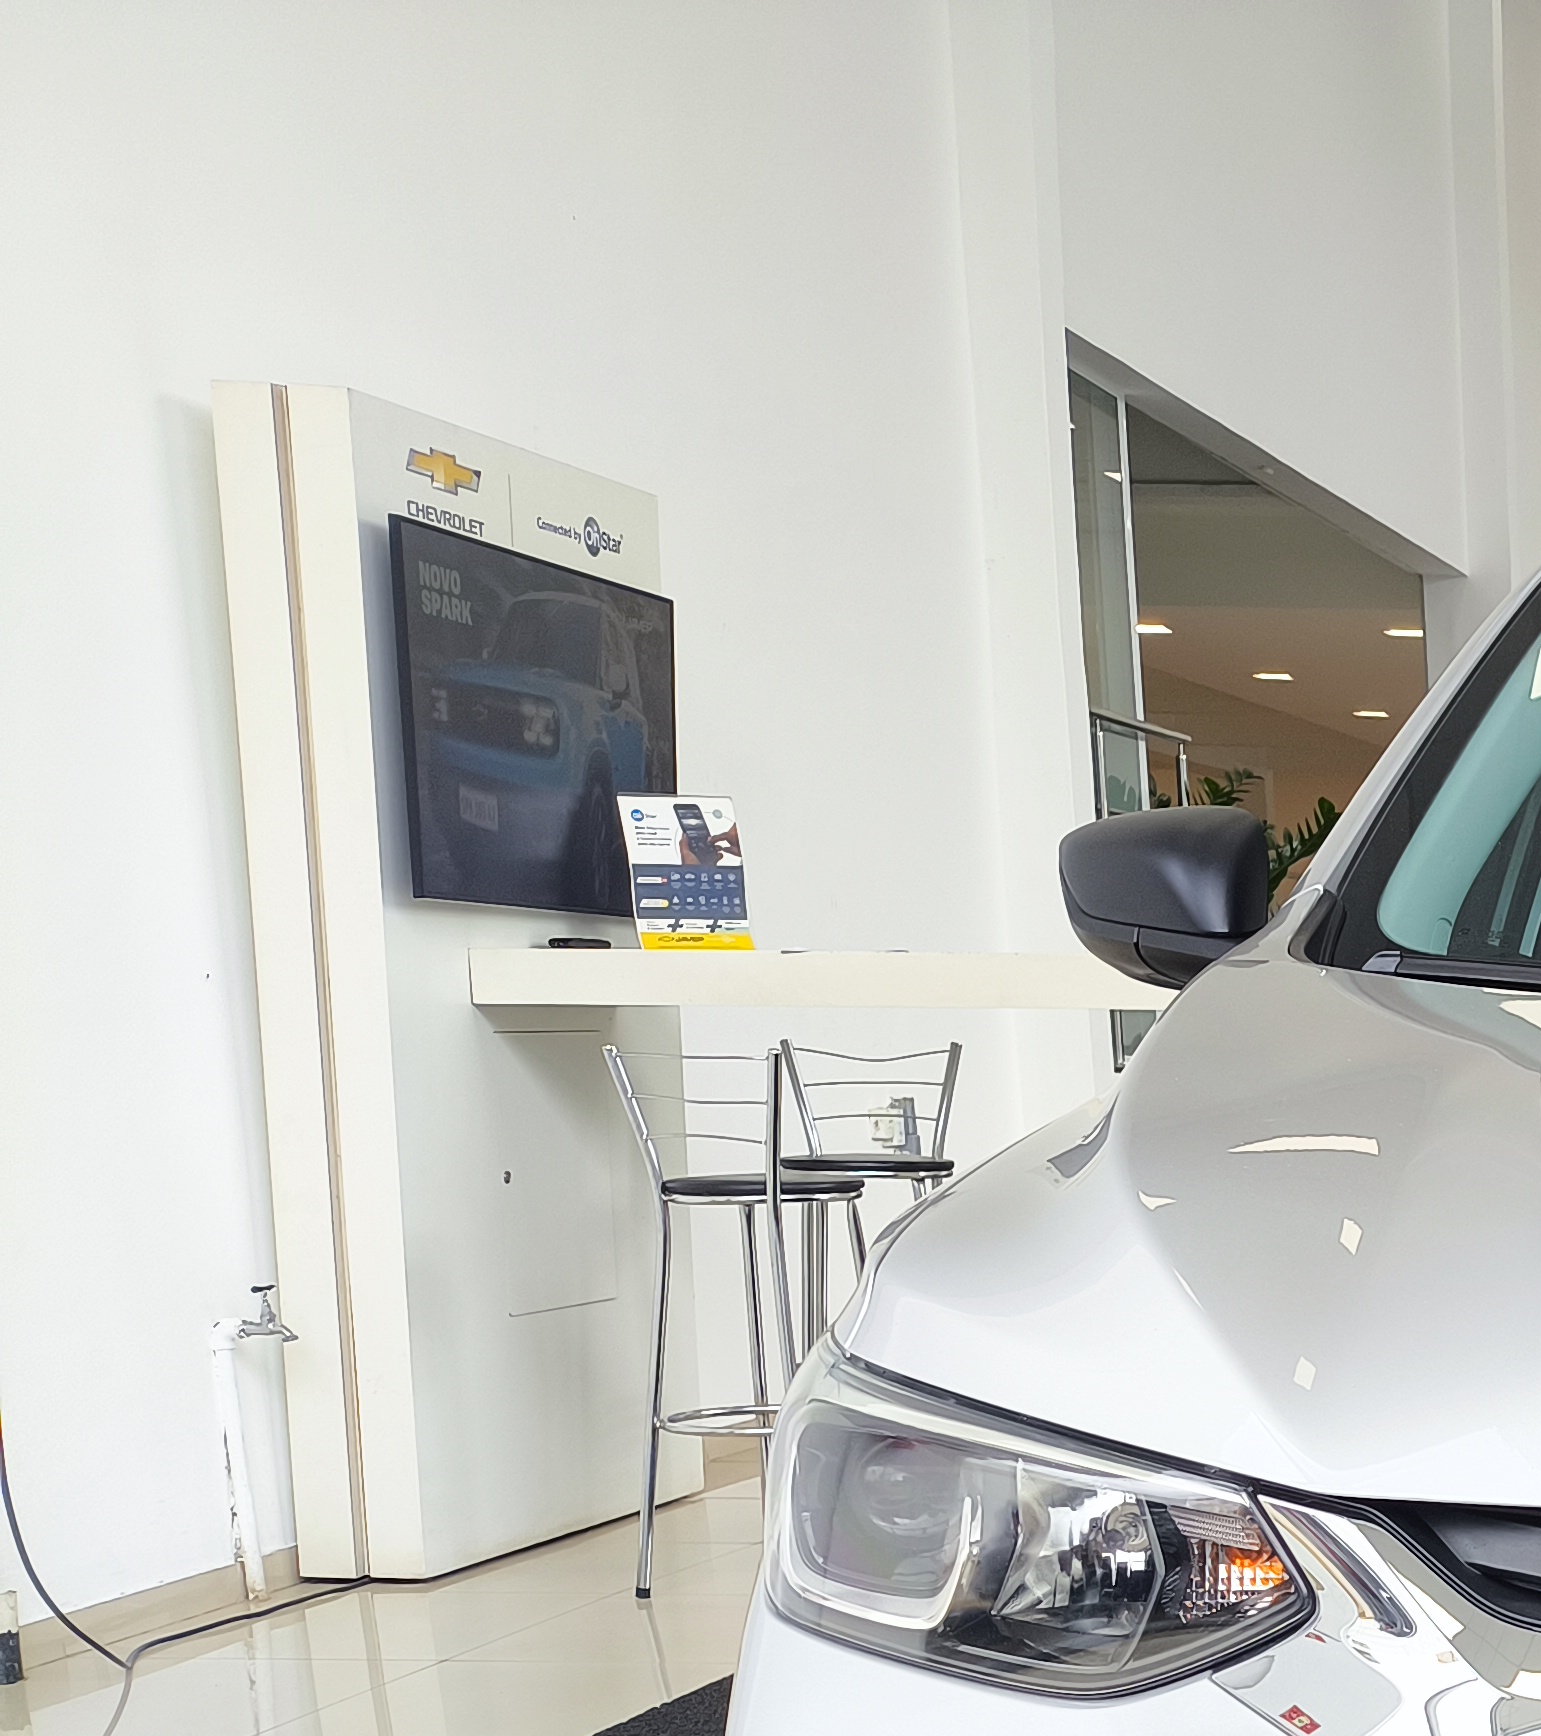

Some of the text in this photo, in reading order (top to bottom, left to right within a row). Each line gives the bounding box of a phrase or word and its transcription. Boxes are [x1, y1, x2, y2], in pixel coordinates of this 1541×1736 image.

[407, 500, 485, 538] CHEVROLET
[418, 559, 461, 595] NOVO
[421, 589, 473, 626] SPARK
